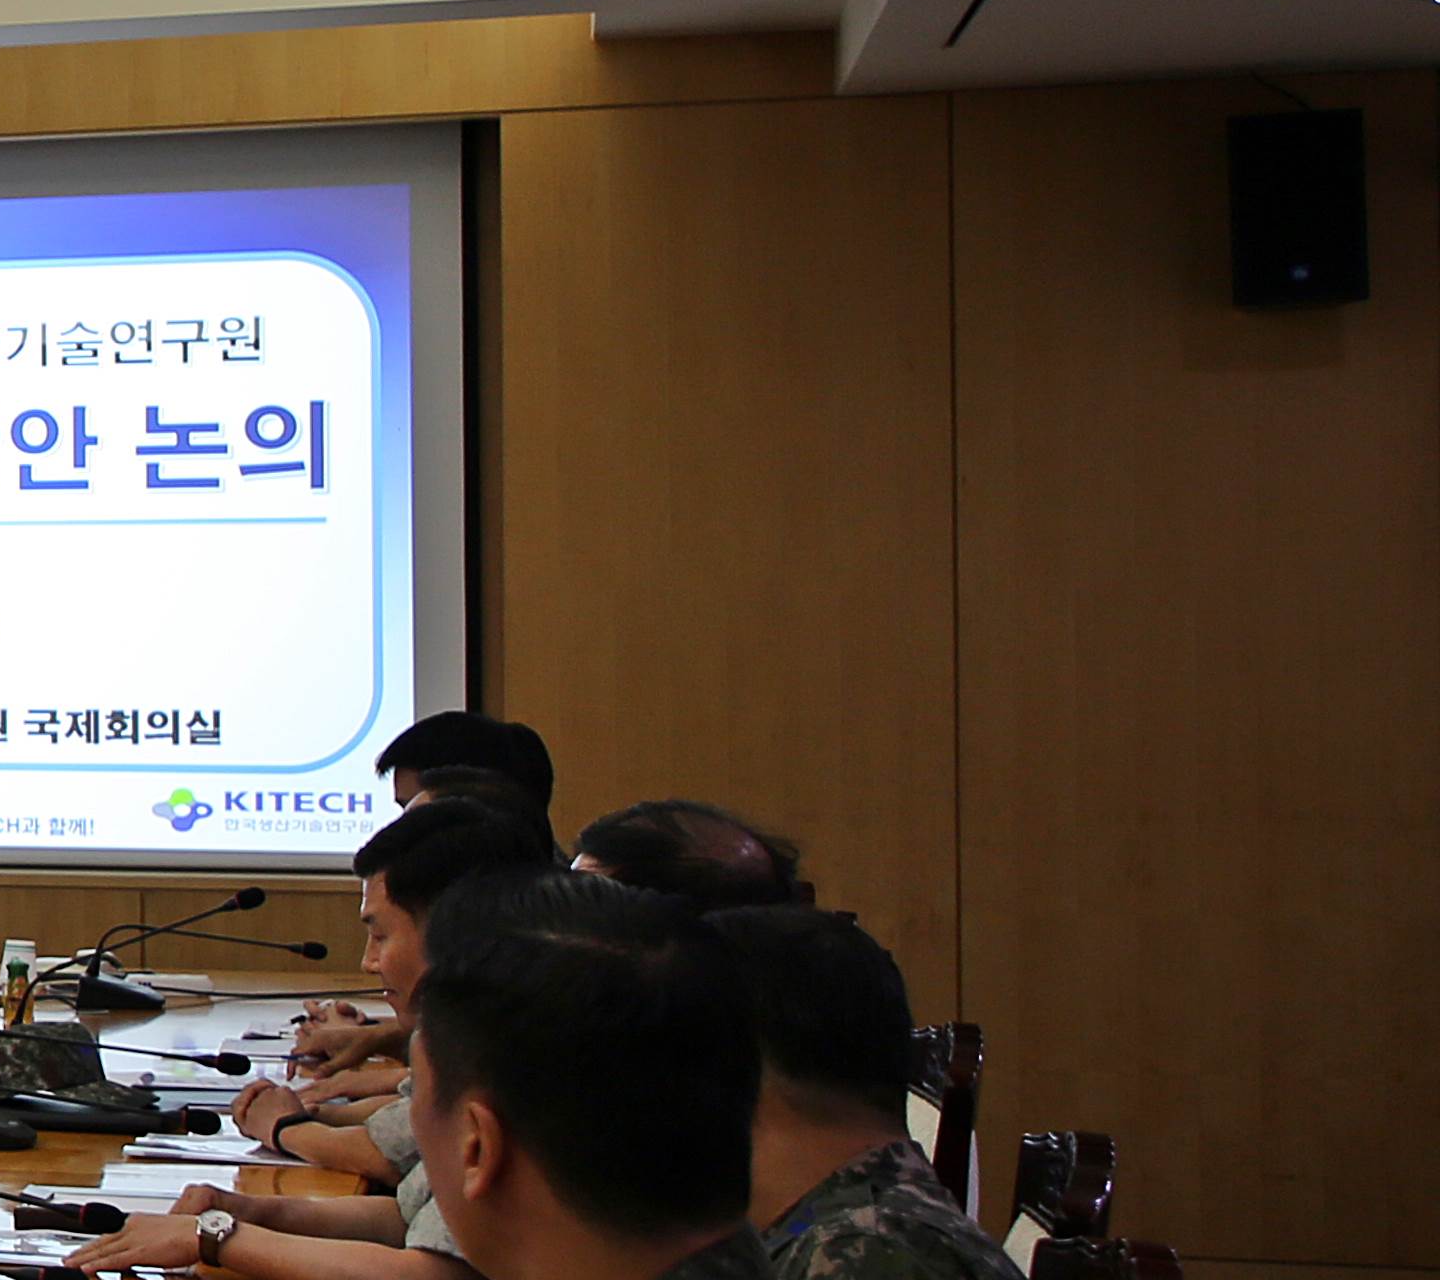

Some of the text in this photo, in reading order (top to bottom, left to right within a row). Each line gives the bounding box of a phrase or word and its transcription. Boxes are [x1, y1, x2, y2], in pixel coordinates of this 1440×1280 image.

[136, 400, 324, 489] 논의
[24, 710, 221, 745] 국제회의실
[225, 792, 372, 813] KITECH
[50, 817, 95, 836] 함께!
[225, 818, 375, 835] 한국생산기술연구원
